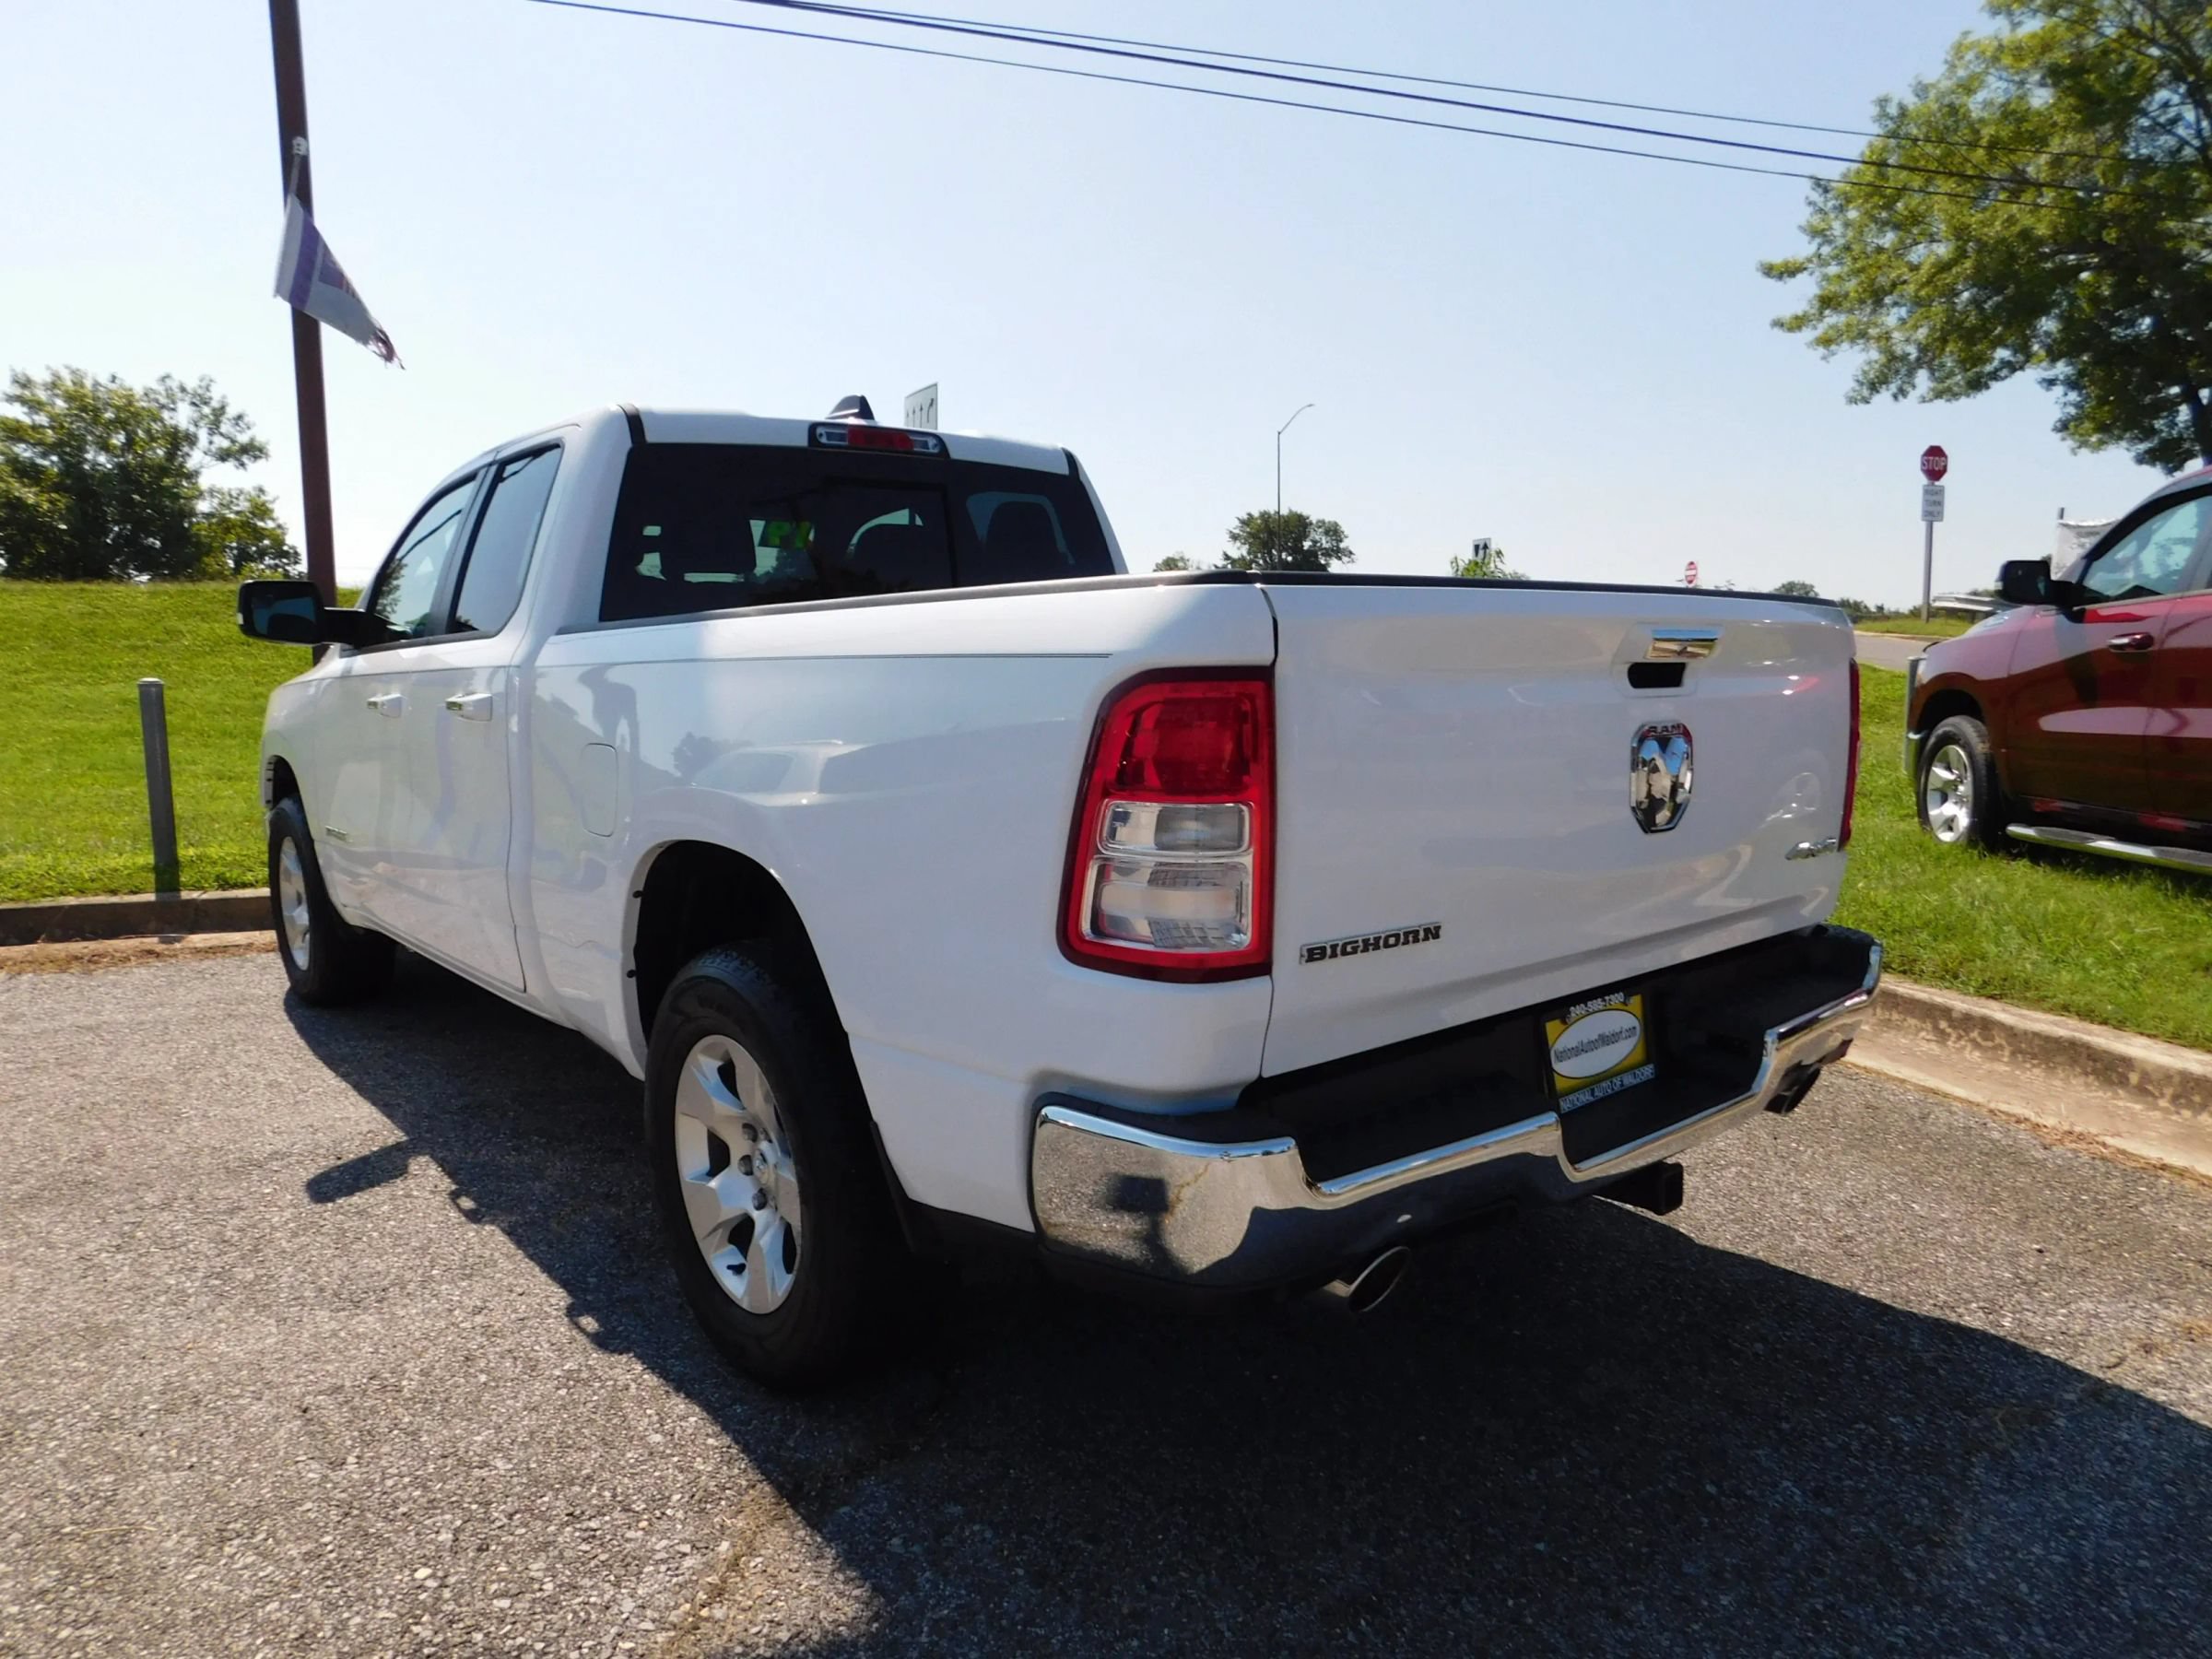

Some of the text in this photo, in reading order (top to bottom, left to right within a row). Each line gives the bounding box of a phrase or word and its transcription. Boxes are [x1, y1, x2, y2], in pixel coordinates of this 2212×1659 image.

[1922, 456, 1947, 470] STOP
[1649, 724, 1682, 735] RAM
[1560, 1065, 1654, 1112] NATIONAL AUTO OF WALDORF
